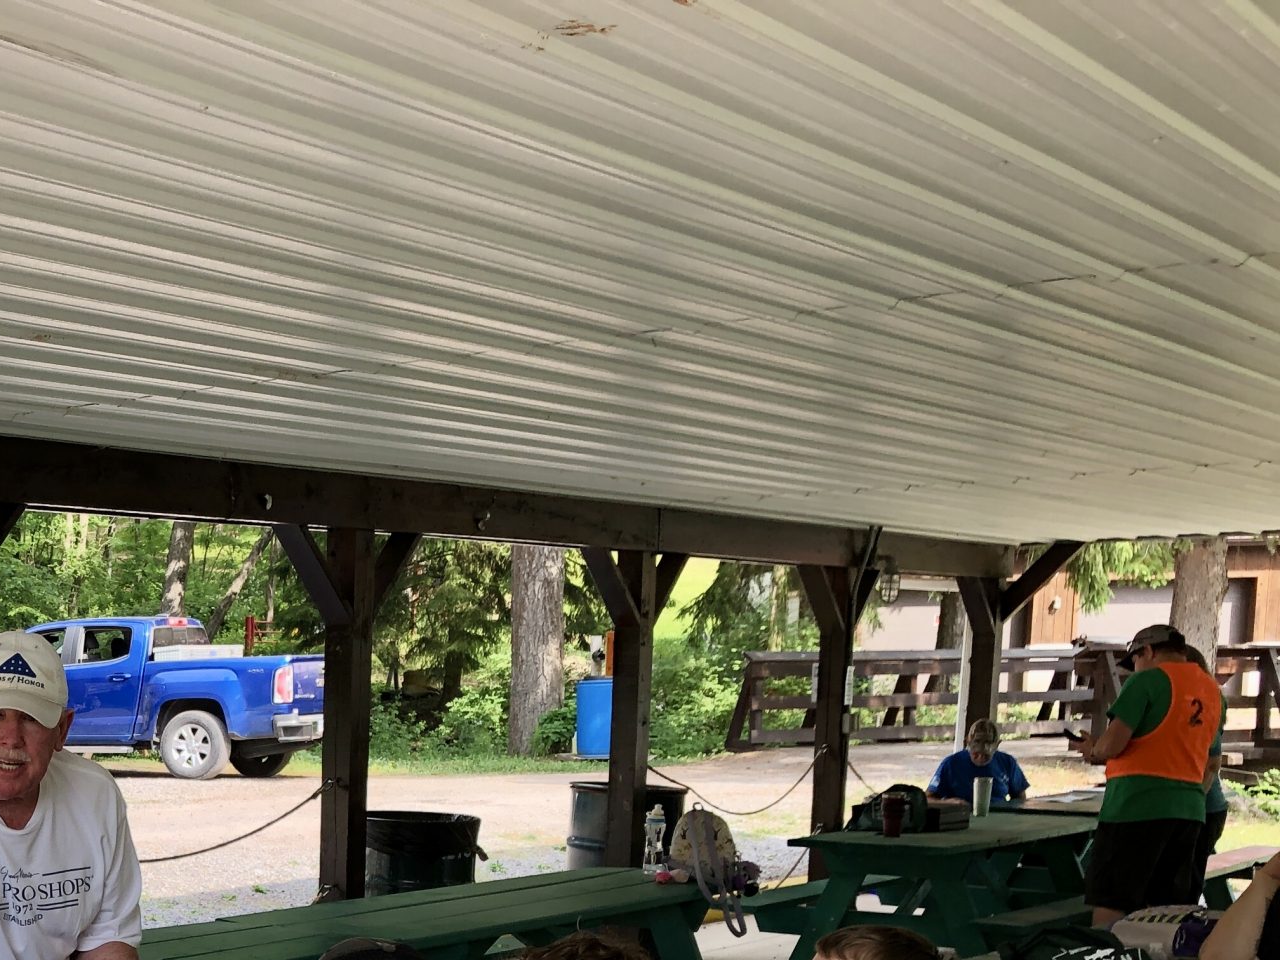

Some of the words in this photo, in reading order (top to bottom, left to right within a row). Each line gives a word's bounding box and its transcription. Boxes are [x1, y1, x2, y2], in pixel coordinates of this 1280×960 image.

[1188, 698, 1205, 728] 2
[2, 882, 36, 903] PRO
[37, 876, 91, 900] SHOPS
